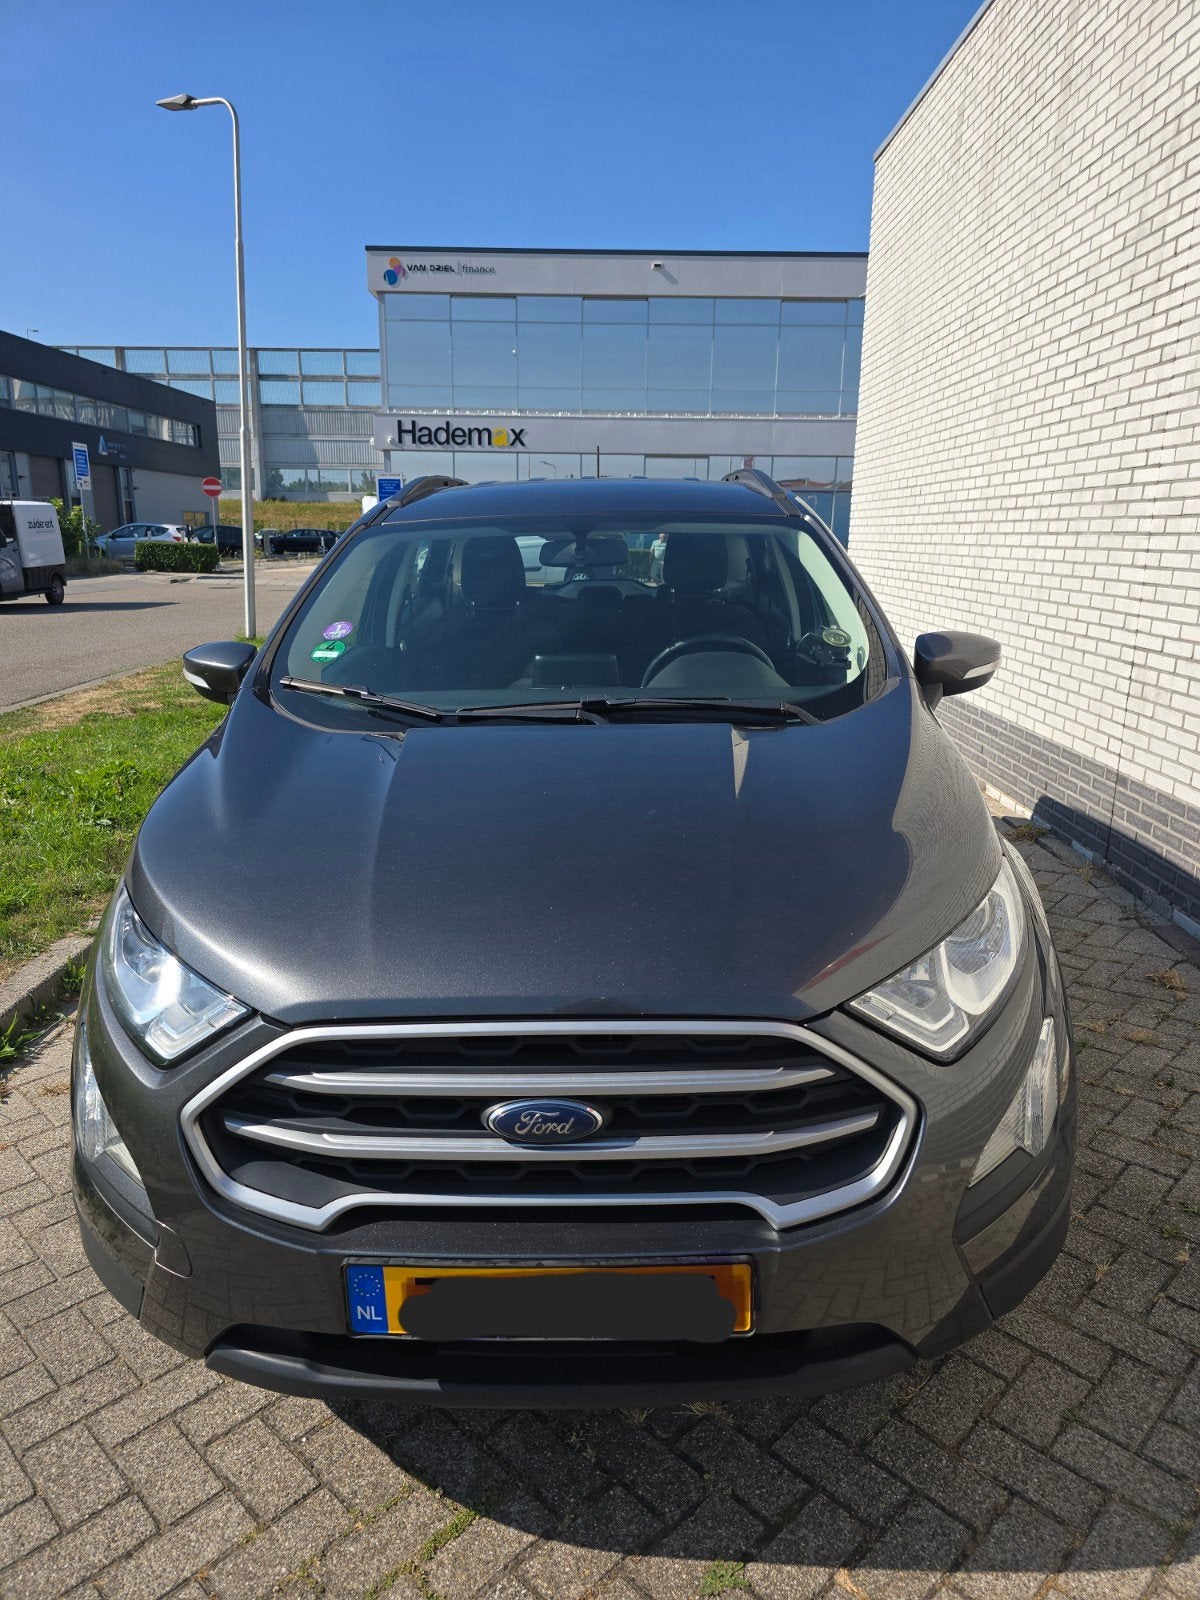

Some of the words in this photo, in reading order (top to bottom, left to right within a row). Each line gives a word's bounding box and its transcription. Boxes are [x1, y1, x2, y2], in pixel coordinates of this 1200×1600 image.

[406, 264, 427, 272] VAN
[429, 264, 455, 273] DRIEL
[462, 264, 496, 274] finance
[397, 419, 527, 447] Hademax
[325, 641, 337, 652] 4
[514, 1110, 576, 1135] Ford
[356, 1305, 382, 1321] NL
